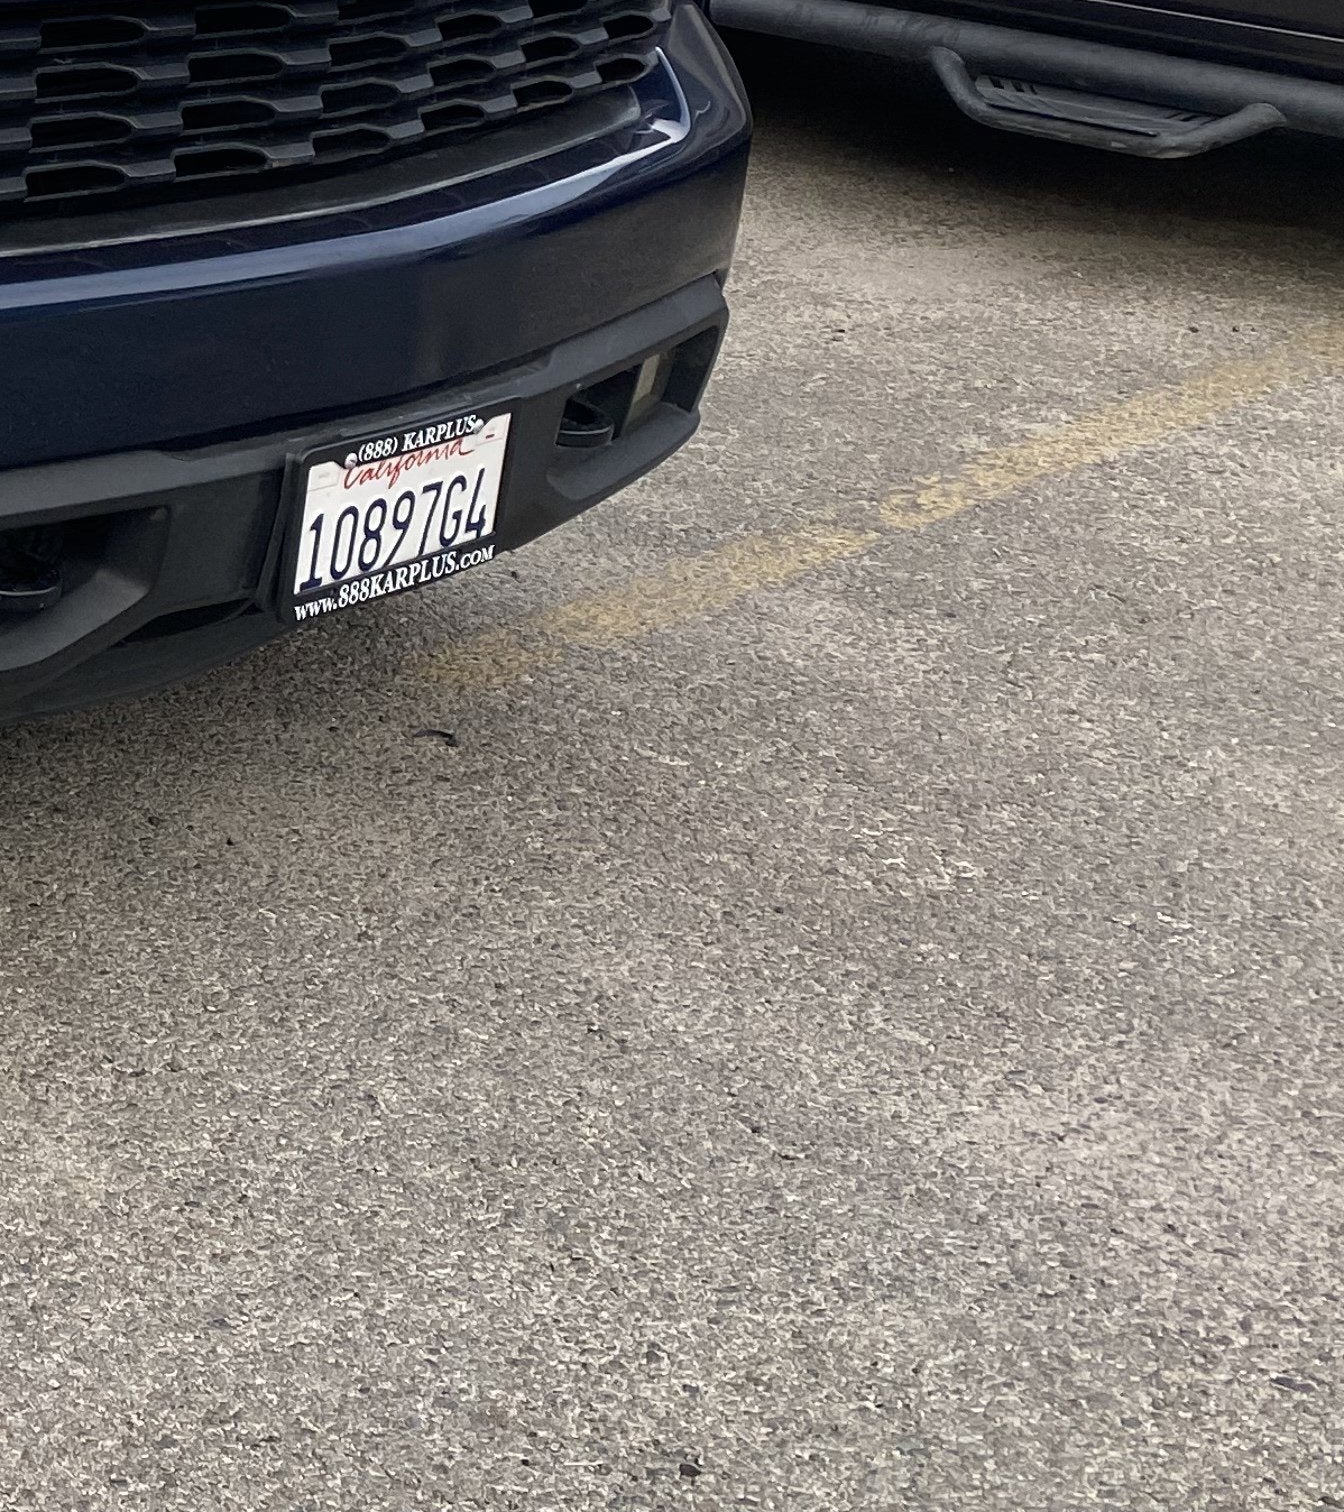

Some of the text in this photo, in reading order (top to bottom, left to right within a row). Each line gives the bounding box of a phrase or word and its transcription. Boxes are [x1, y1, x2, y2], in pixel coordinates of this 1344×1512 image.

[343, 438, 475, 489] California
[358, 414, 477, 463] (888) KARPLUS
[298, 467, 488, 588] 10897G4
